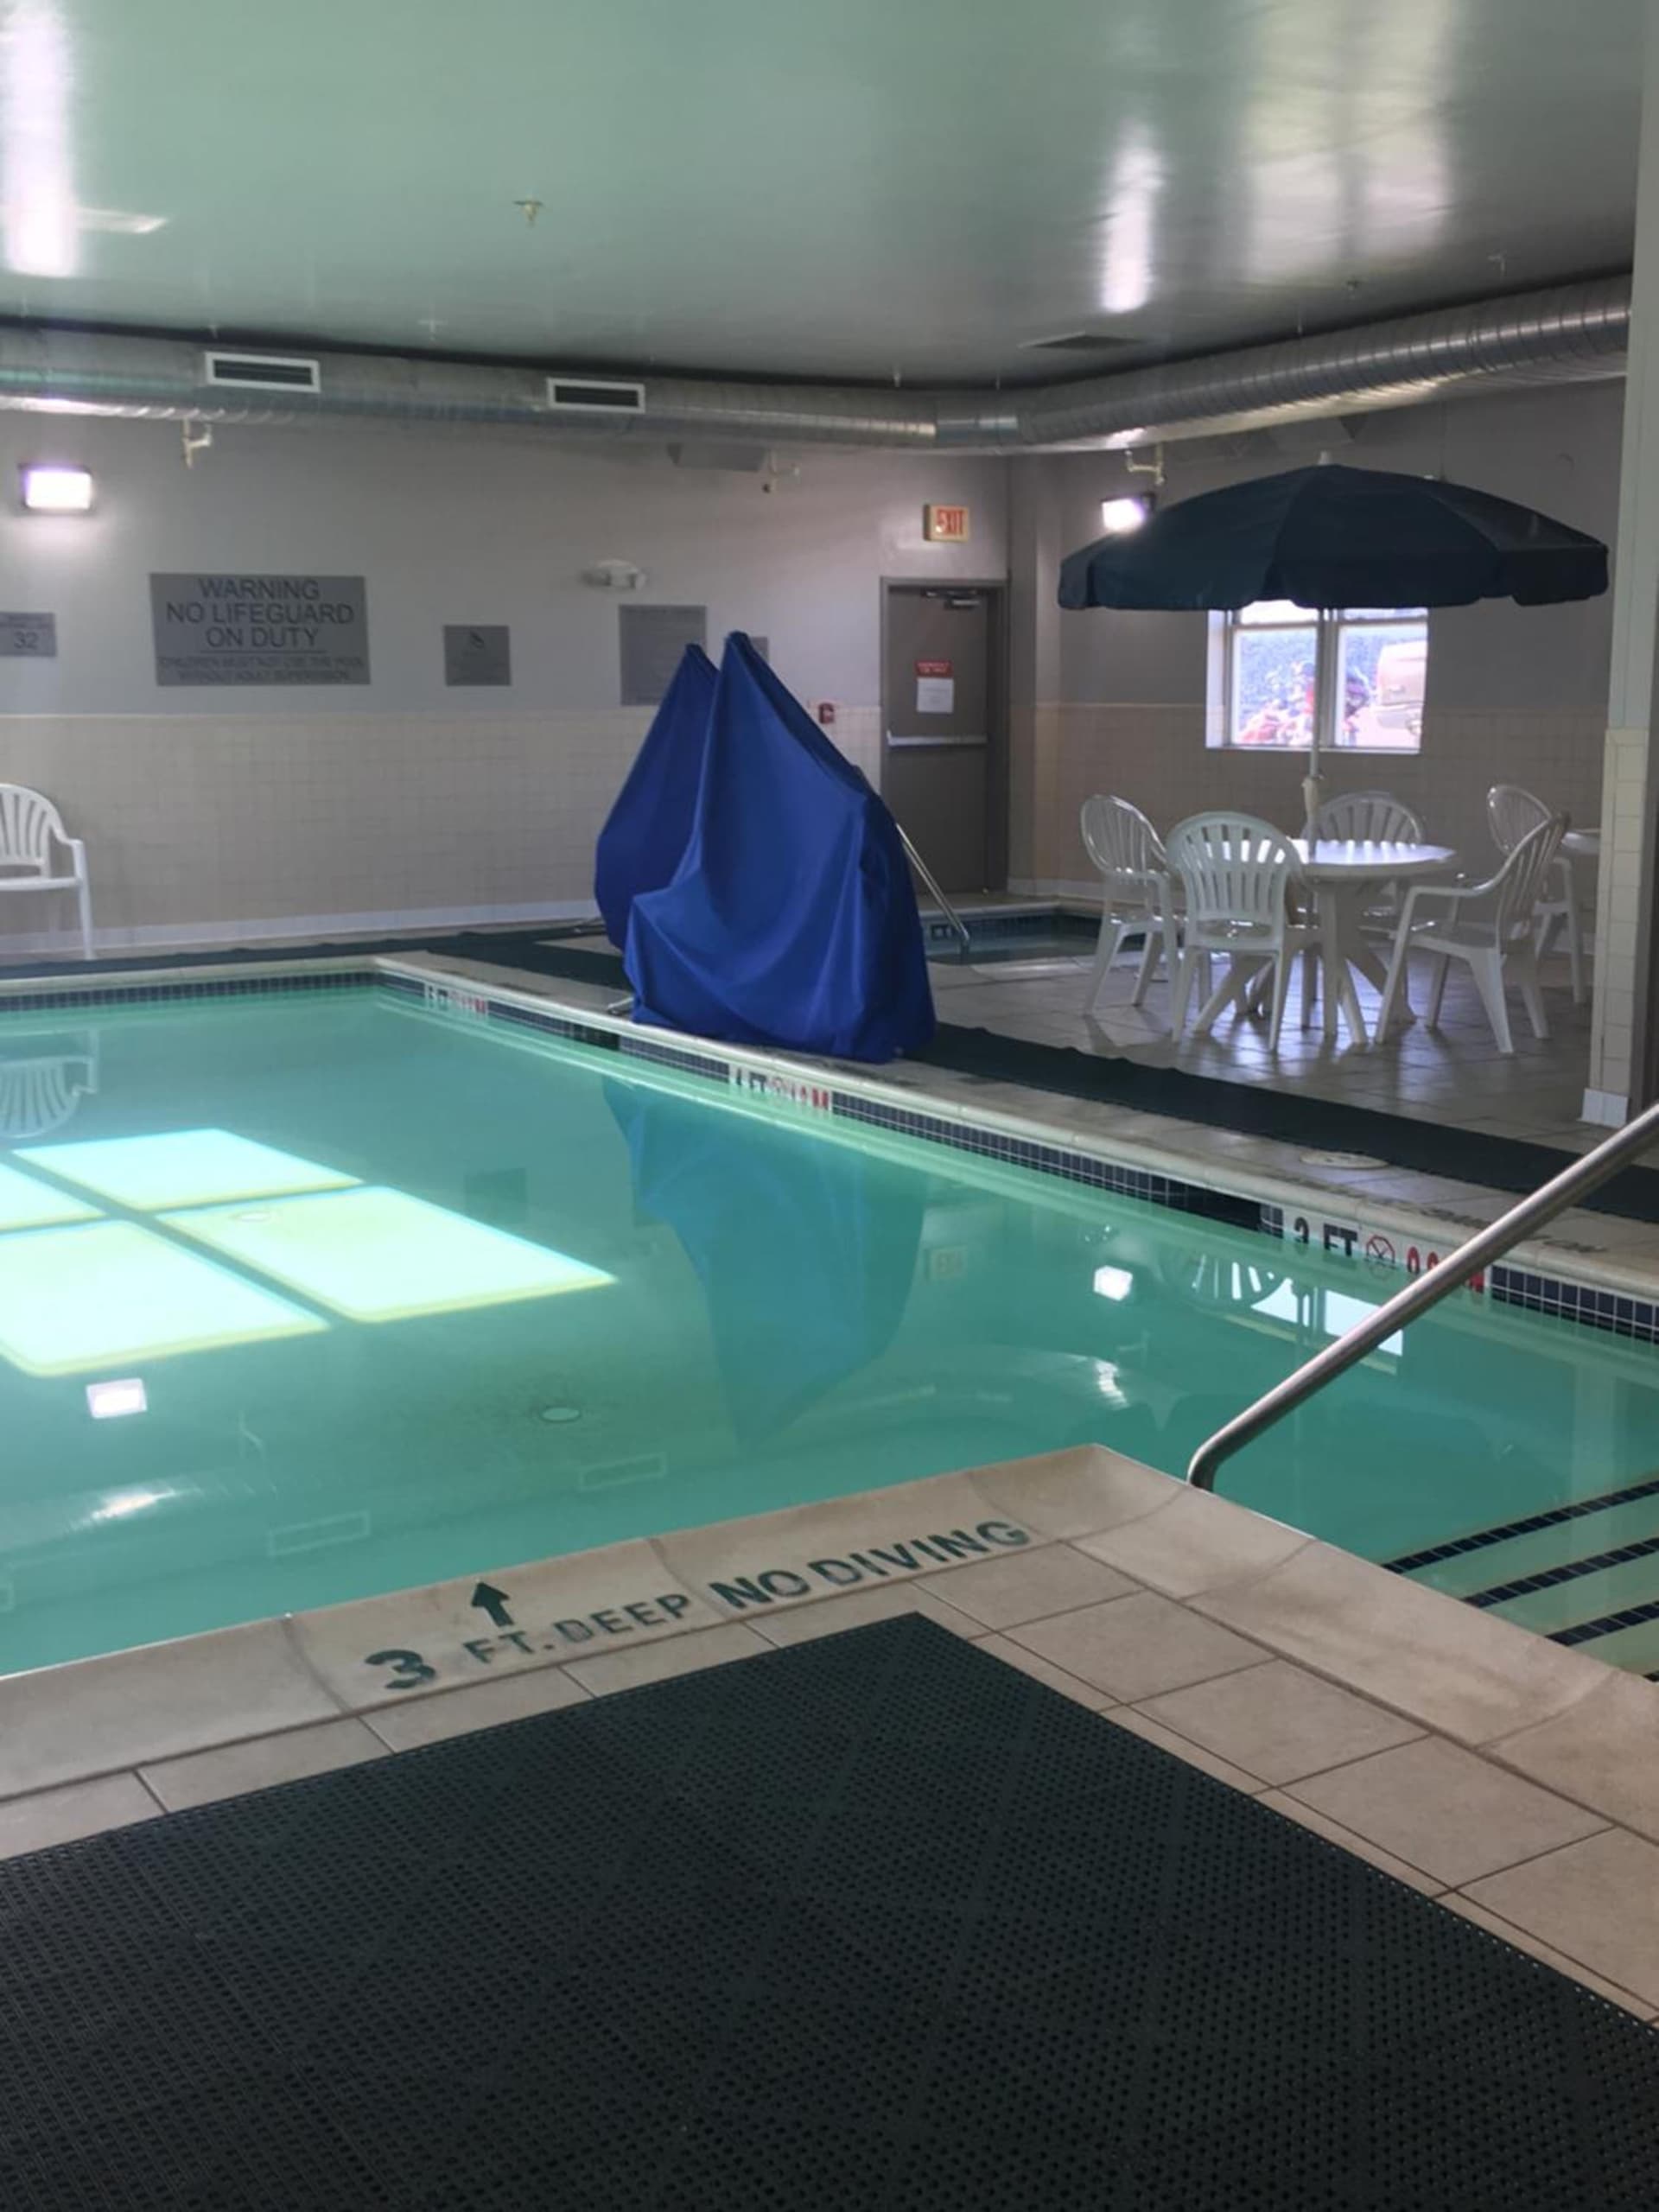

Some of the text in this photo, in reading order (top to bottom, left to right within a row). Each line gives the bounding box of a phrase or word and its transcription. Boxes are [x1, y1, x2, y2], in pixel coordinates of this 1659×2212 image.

[198, 578, 320, 601] WARNING
[166, 602, 355, 624] NO LIFEGUARD
[14, 631, 38, 650] 32
[206, 626, 319, 647] ON DUTY
[1323, 1223, 1358, 1256] FT
[365, 1649, 436, 1690] 3
[553, 1594, 690, 1643] DEEP
[709, 1569, 811, 1610] NO
[808, 1521, 1031, 1586] DIVING
